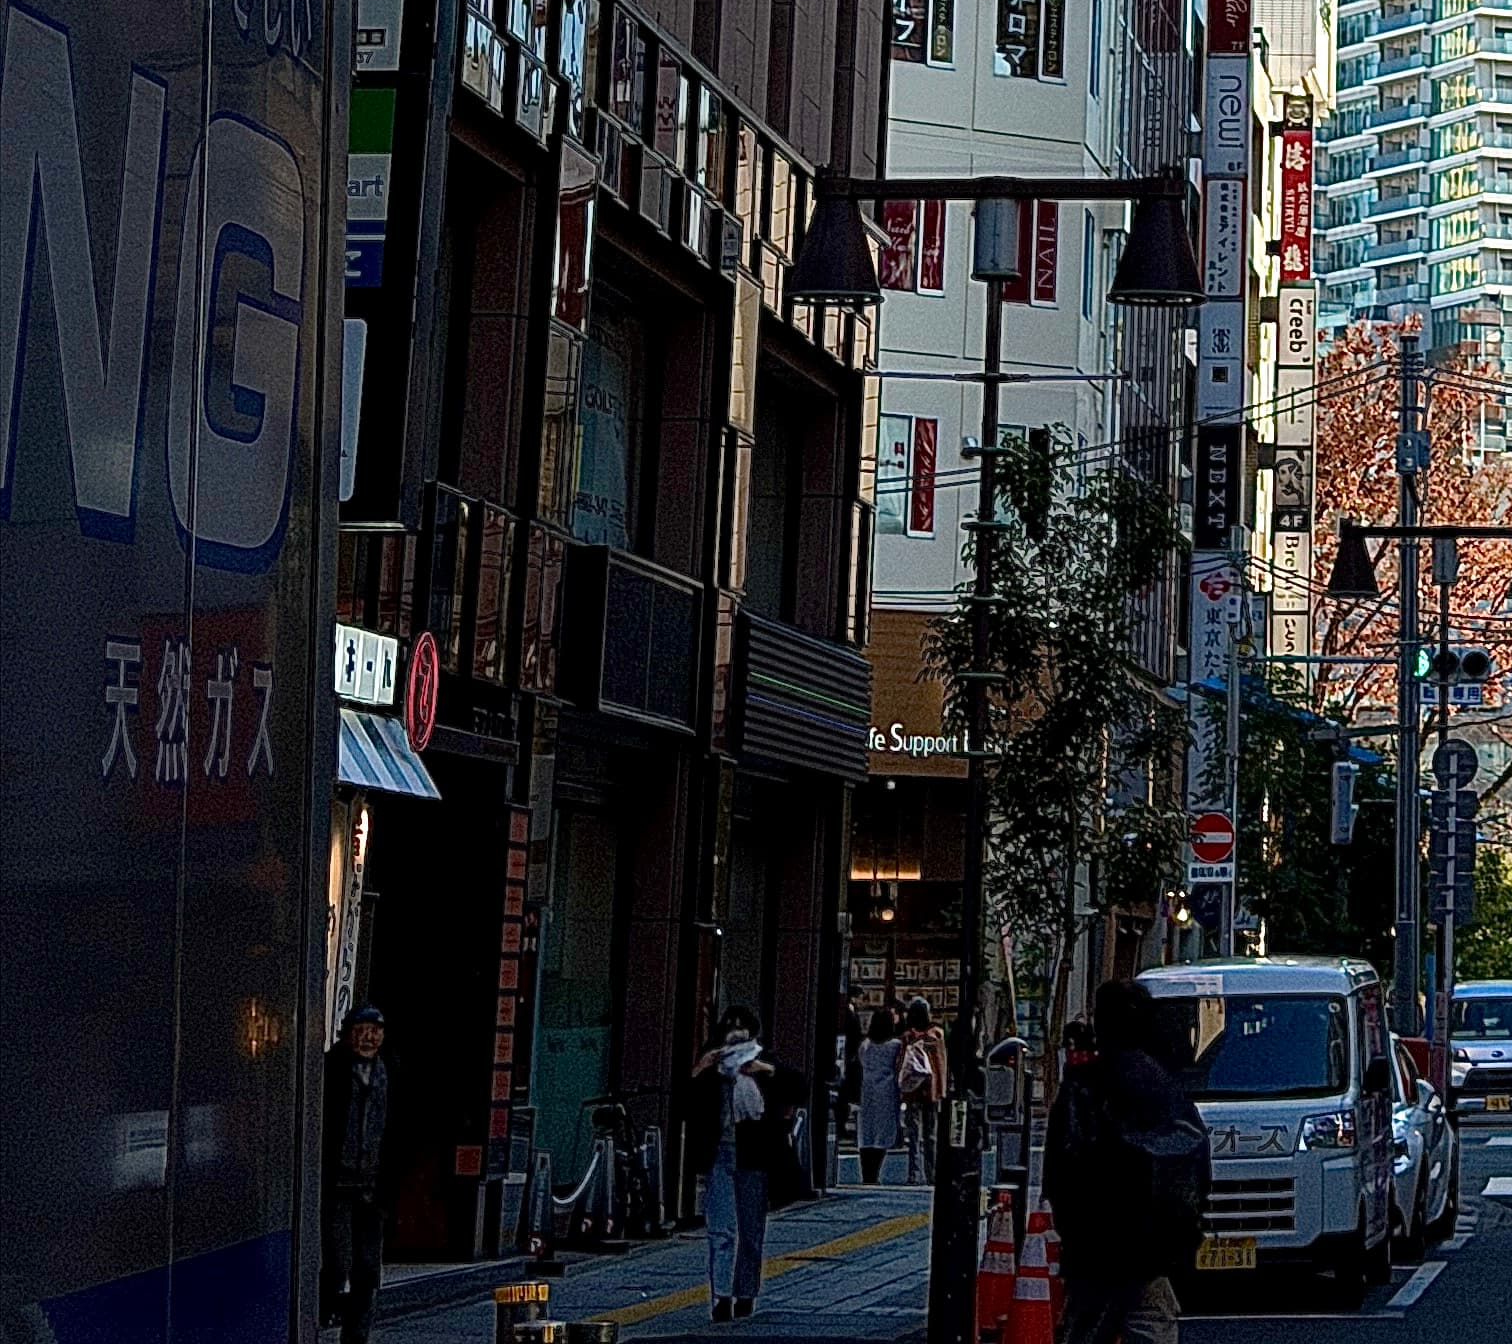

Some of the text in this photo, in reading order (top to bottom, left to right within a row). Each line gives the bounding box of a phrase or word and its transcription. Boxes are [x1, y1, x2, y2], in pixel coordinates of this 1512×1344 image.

[1037, 216, 1057, 289] NAIL
[1208, 443, 1227, 529] NEXT
[1279, 514, 1304, 528] 4F
[101, 635, 275, 783] 天然ガス
[889, 723, 959, 758] Support
[1207, 1124, 1288, 1153] オーズ
